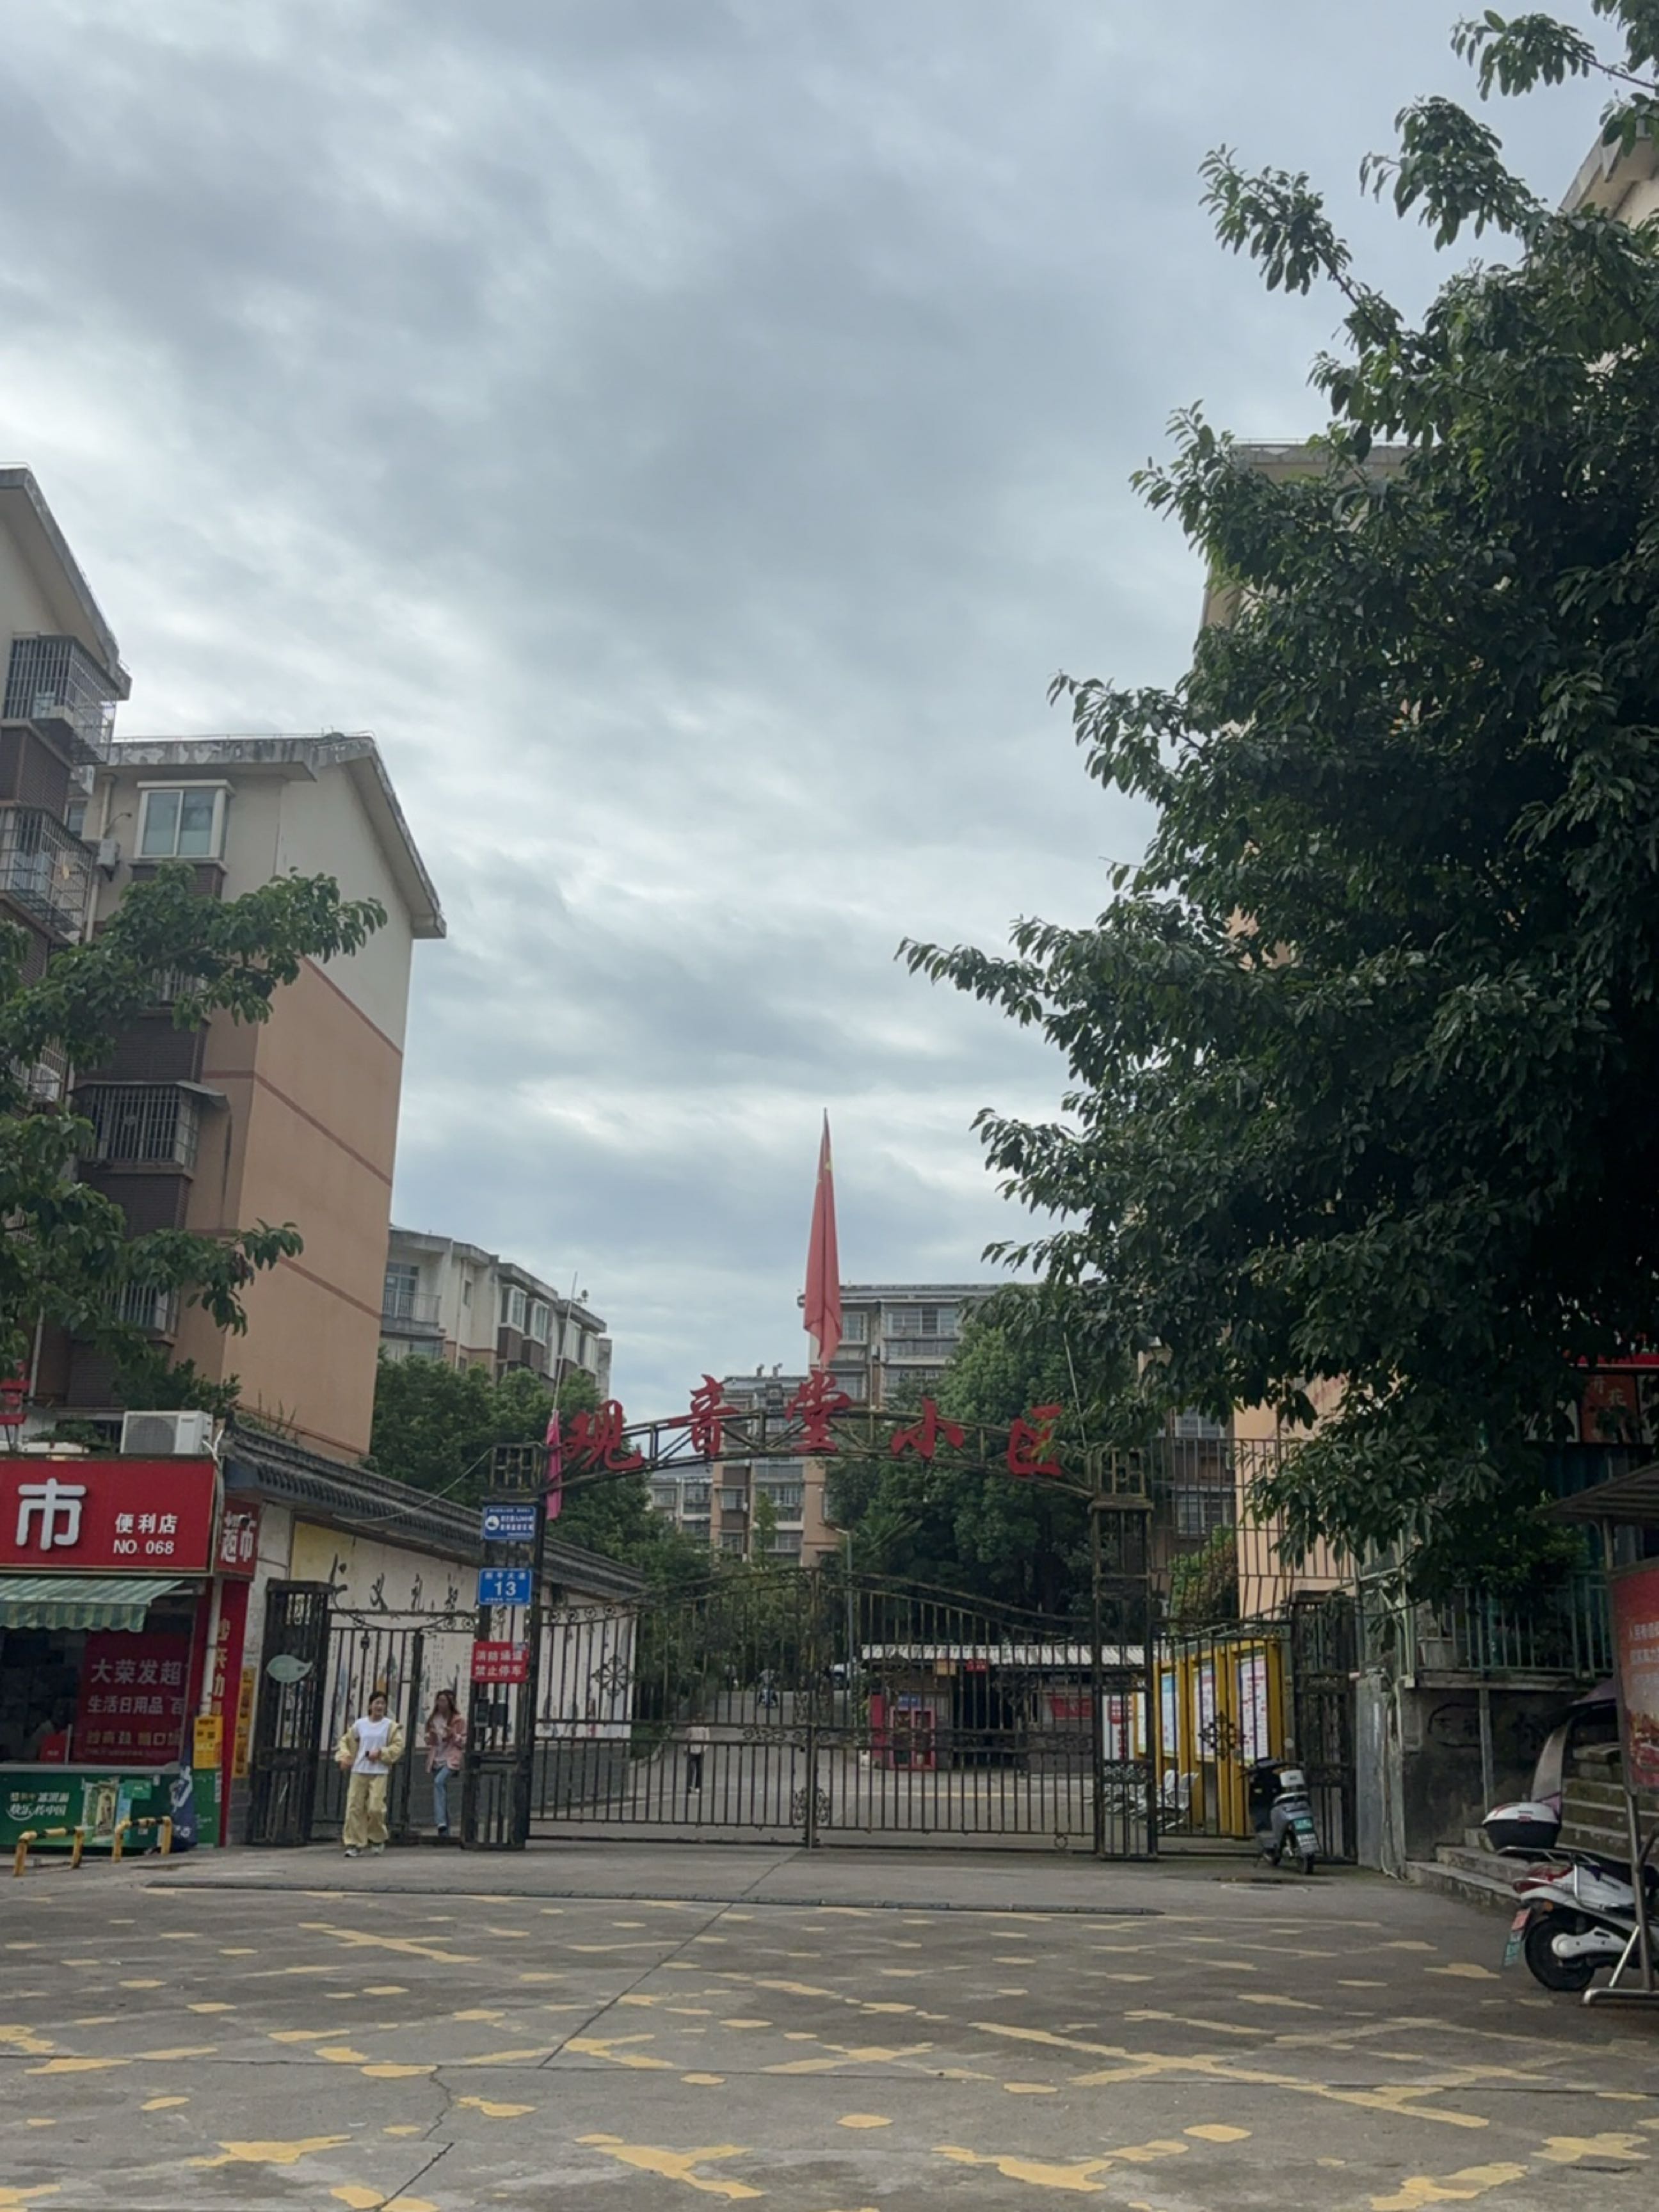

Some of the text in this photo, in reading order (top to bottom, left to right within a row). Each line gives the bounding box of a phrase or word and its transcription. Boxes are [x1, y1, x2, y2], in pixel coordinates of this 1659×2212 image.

[563, 1372, 1062, 1476] 观音堂小区
[15, 1478, 86, 1551] 市
[115, 1512, 178, 1535] 便利店
[145, 1541, 175, 1555] 068
[494, 1581, 517, 1596] 13
[90, 1658, 189, 1686] 大荣发超
[87, 1695, 163, 1715] 生活日用品
